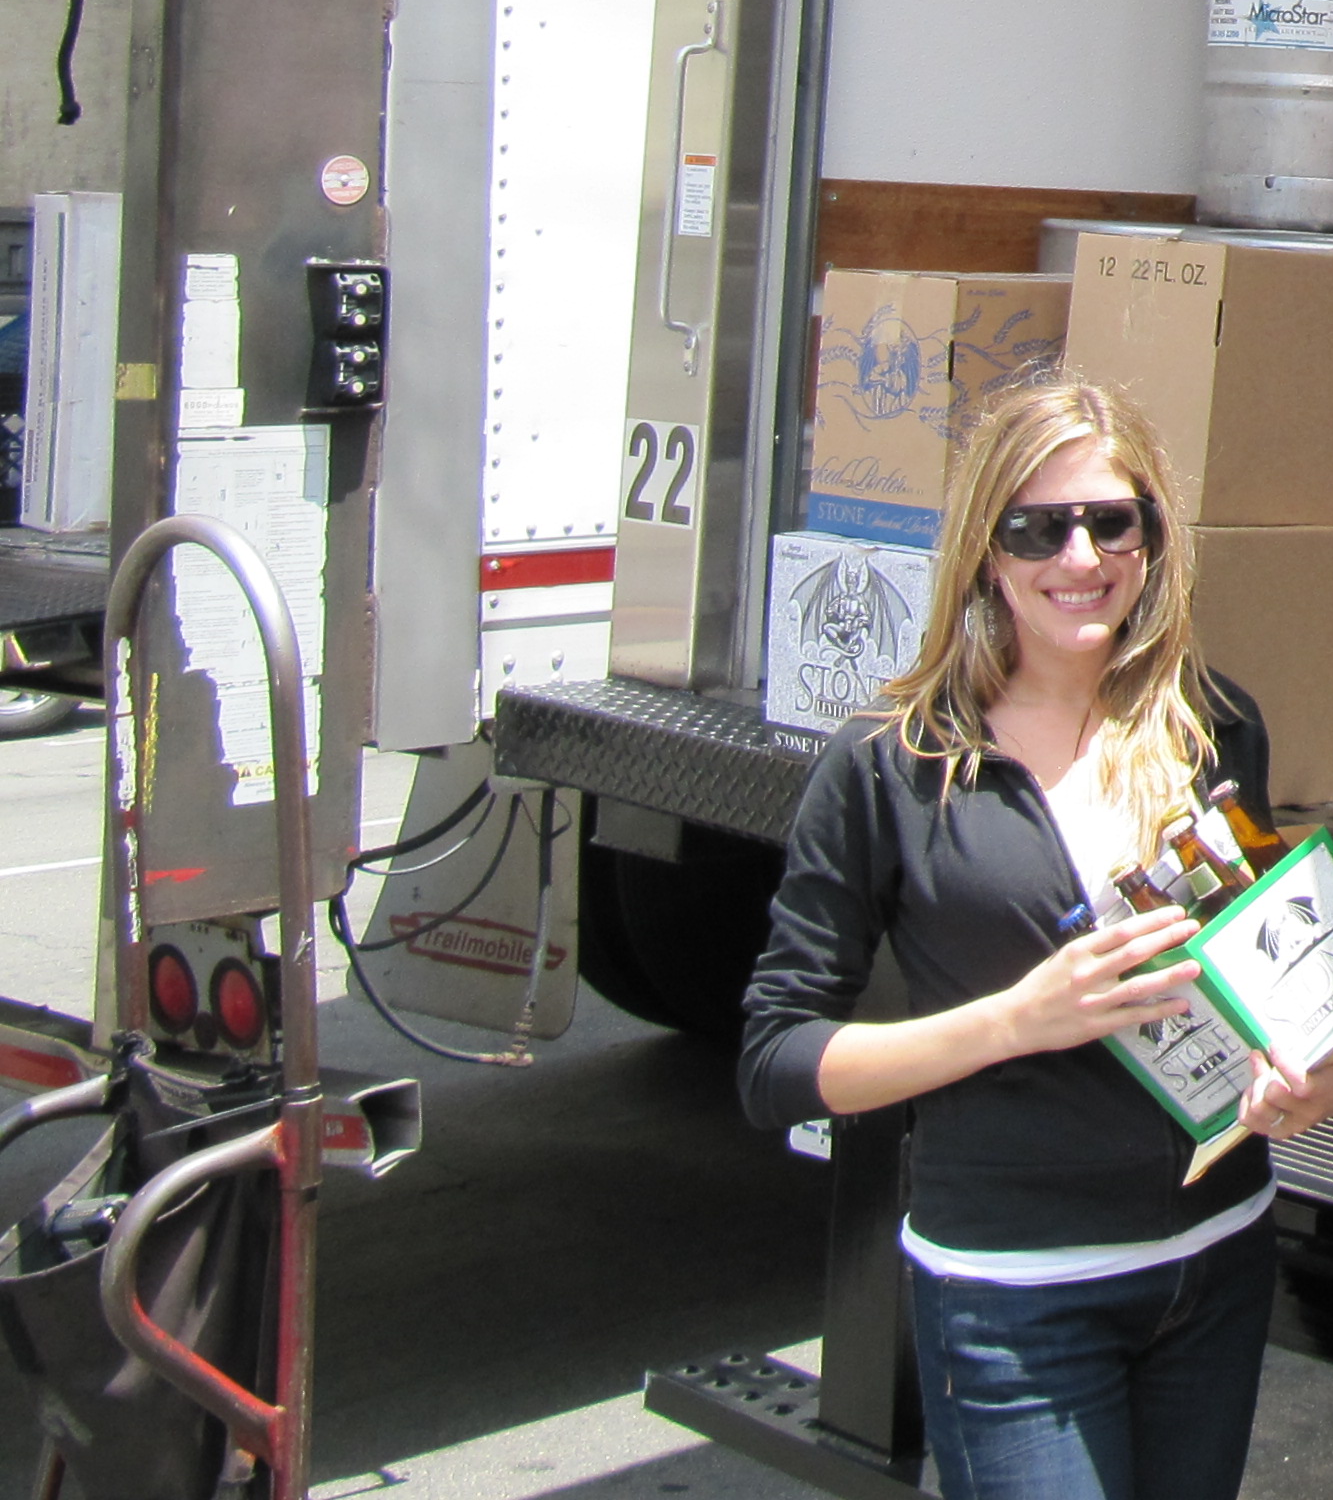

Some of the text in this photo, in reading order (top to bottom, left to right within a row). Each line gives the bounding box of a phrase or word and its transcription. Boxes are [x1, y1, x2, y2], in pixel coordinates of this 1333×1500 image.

[1250, 1, 1327, 26] MicroStar
[1099, 257, 1116, 276] 12
[1131, 259, 1150, 280] 22
[1181, 263, 1207, 286] OZ.
[625, 421, 695, 525] 22
[818, 502, 866, 525] STONE
[795, 662, 892, 712] STON
[816, 700, 858, 719] LEVITA
[424, 926, 532, 963] Trailmobile
[1161, 1023, 1241, 1092] STONE
